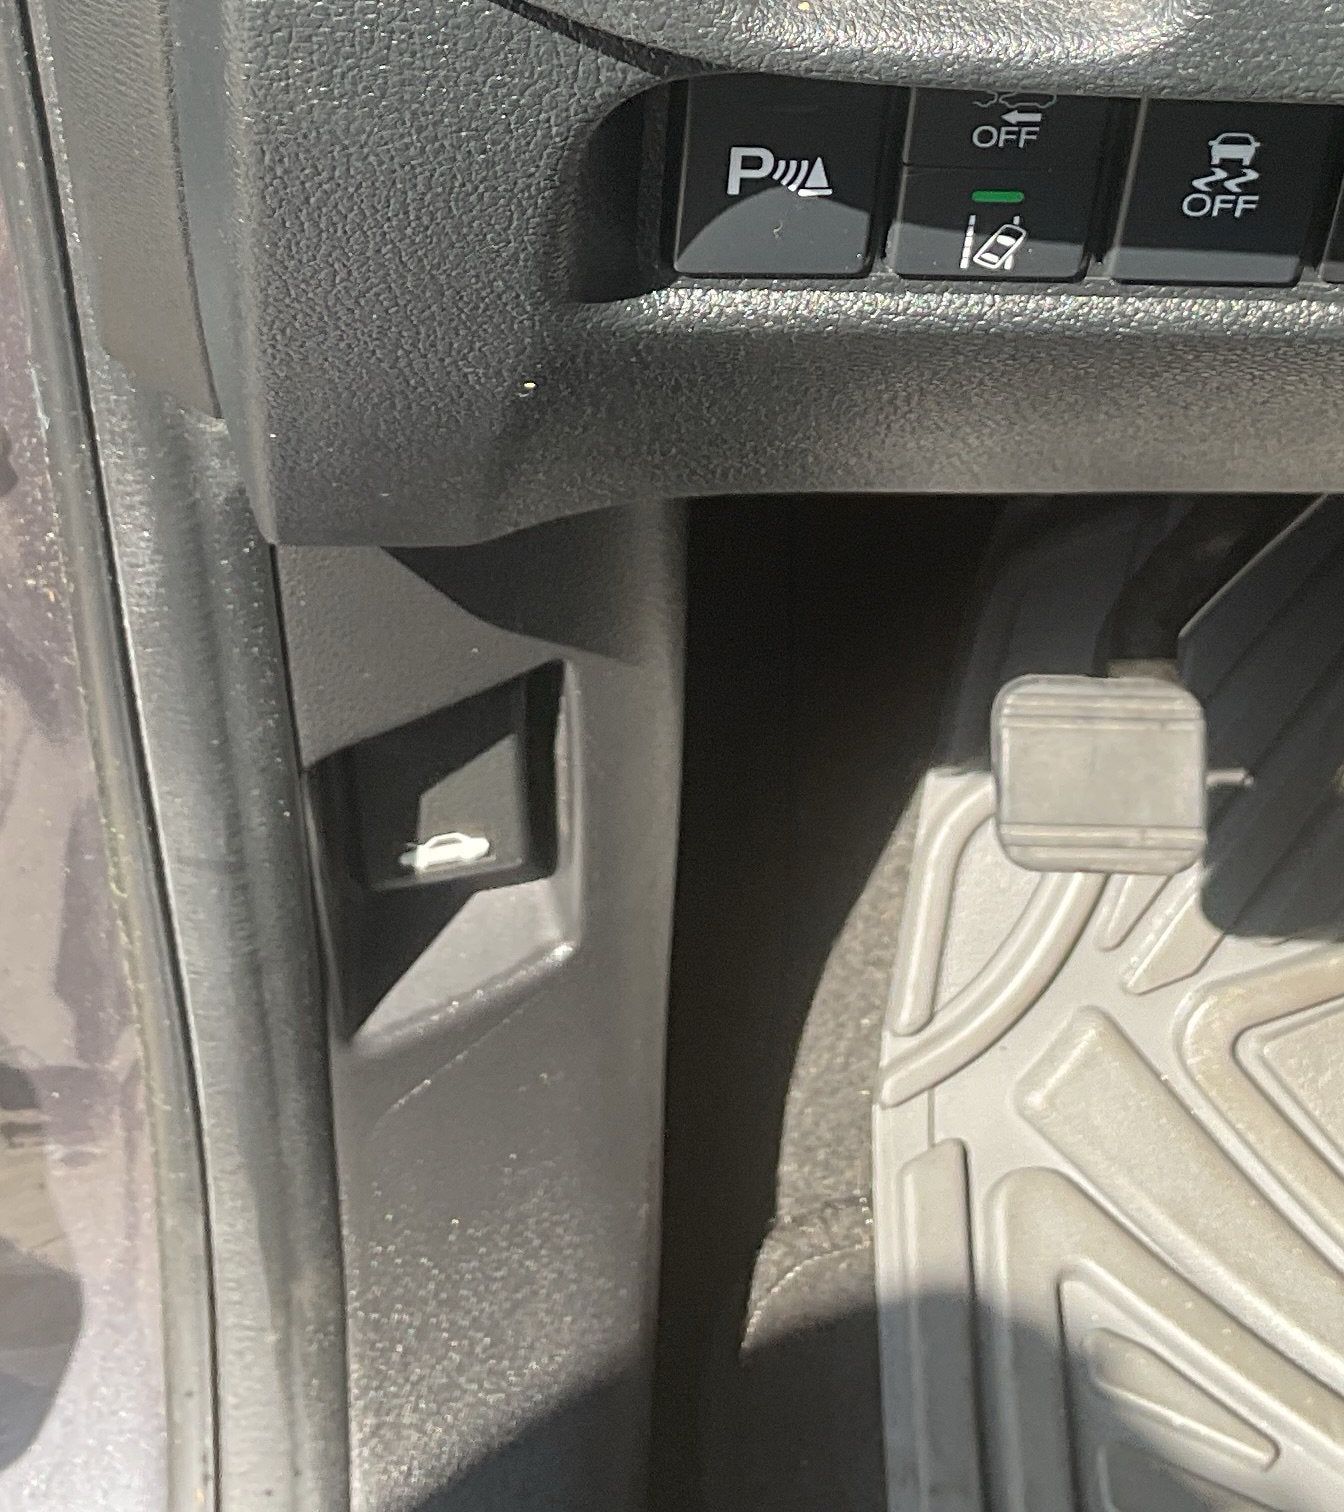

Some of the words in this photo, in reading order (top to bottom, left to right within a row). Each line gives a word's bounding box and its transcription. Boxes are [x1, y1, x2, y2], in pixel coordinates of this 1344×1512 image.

[972, 125, 1040, 150] OFF
[726, 147, 775, 196] P
[1182, 193, 1259, 219] OFF
